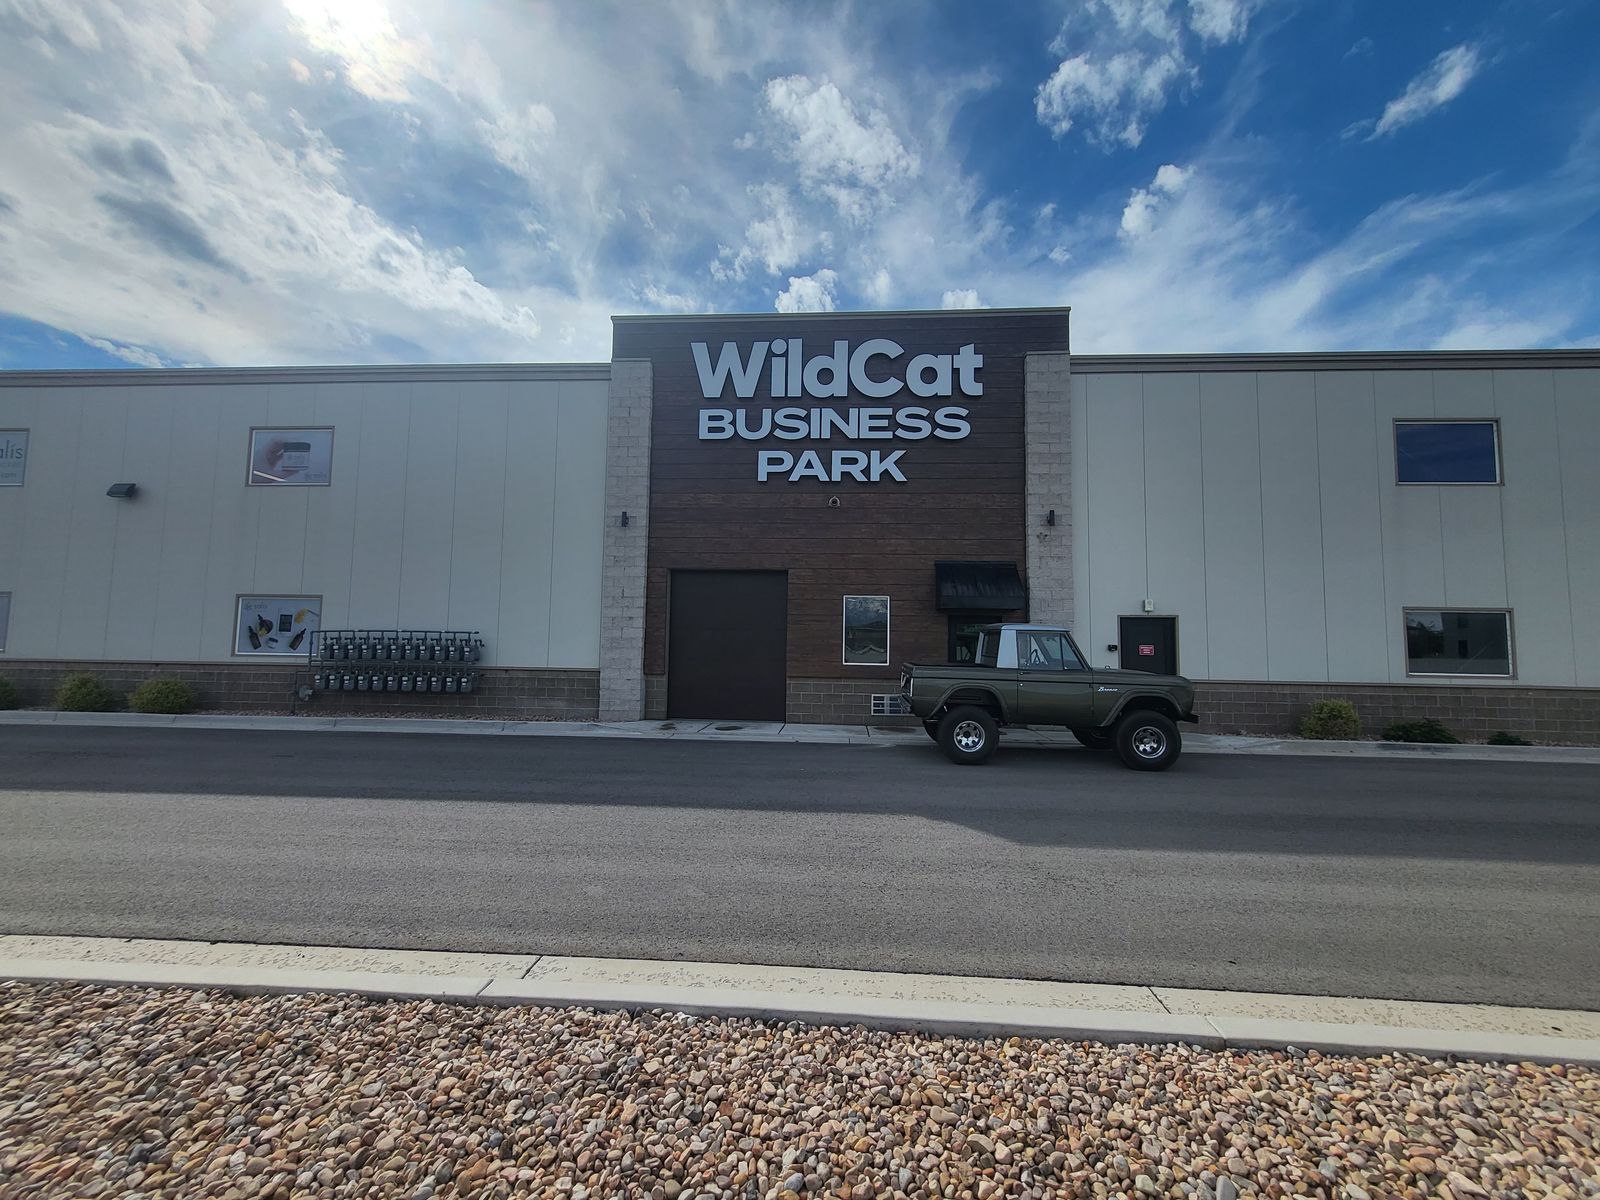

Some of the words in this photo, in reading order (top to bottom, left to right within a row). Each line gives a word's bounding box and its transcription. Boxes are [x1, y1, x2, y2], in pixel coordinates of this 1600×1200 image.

[690, 338, 984, 398] WildCat
[698, 406, 971, 440] BUSINESS
[757, 450, 908, 482] PARK
